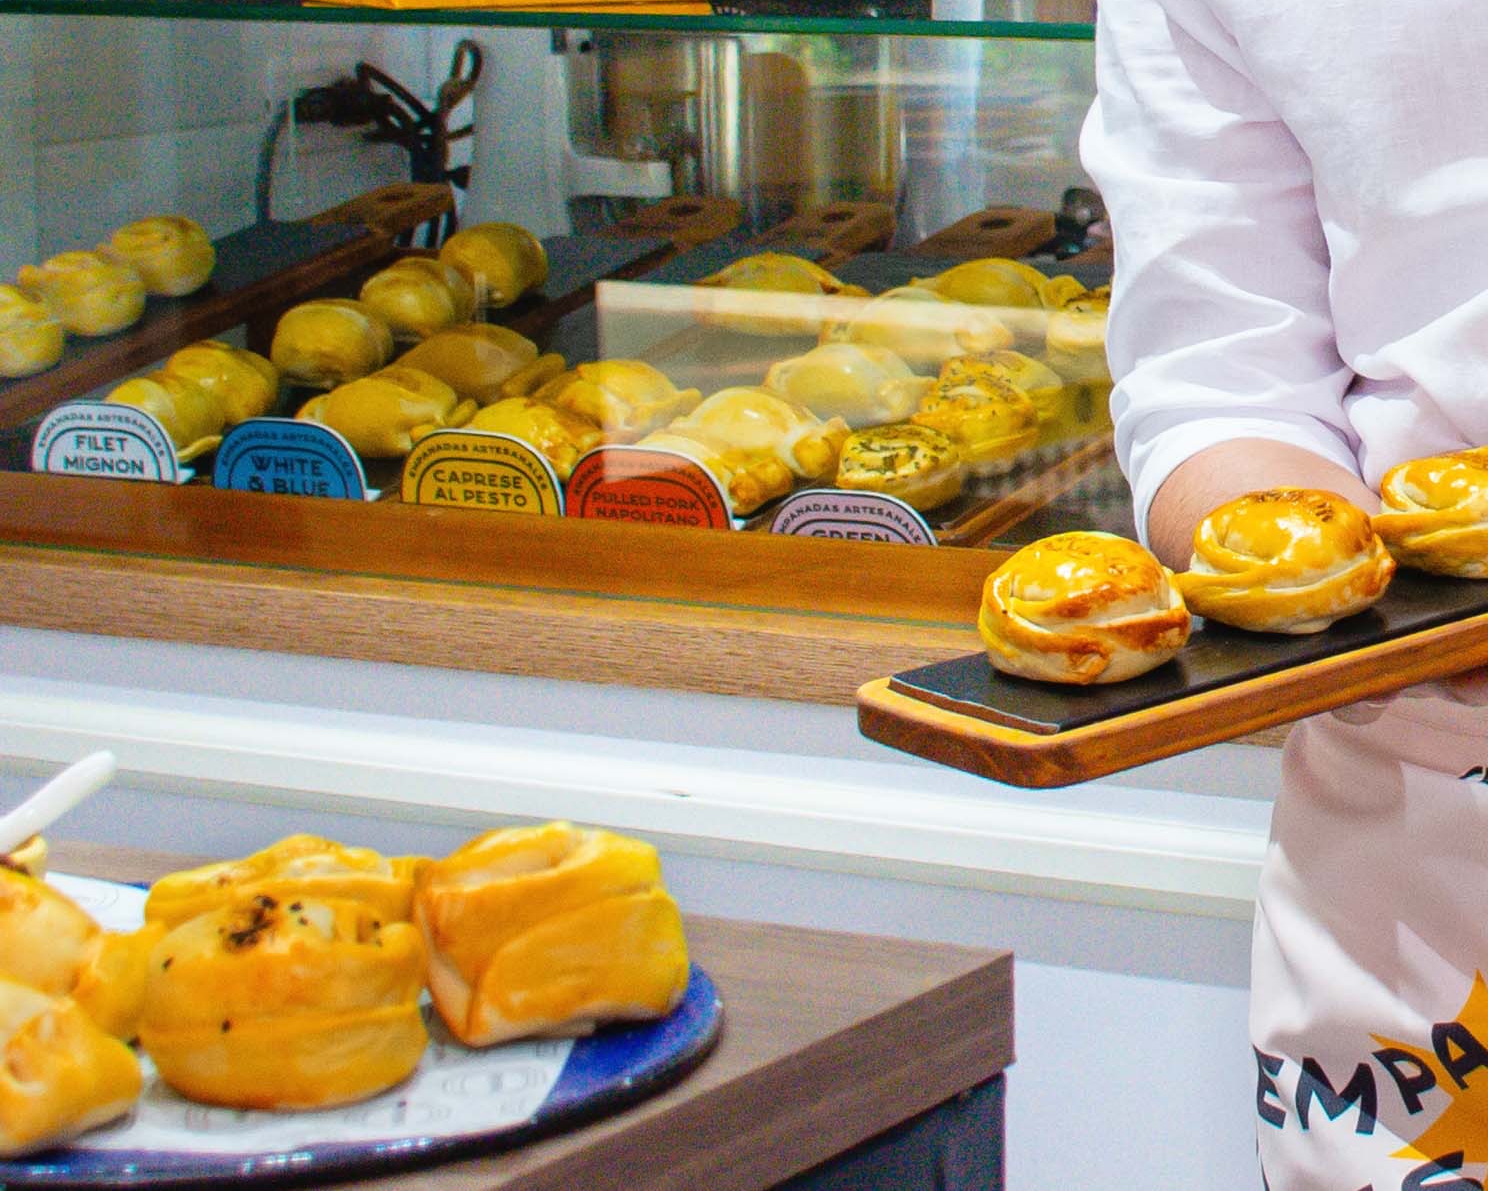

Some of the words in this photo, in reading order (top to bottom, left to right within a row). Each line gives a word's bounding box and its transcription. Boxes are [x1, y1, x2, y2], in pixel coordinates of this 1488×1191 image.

[75, 434, 129, 452] FILET
[63, 455, 145, 475] MIGNON
[251, 455, 323, 476] WHITE
[249, 475, 265, 492] &
[272, 477, 330, 497] BLUE
[433, 469, 523, 490] CAPRESE
[434, 487, 457, 501] AL
[463, 489, 528, 507] PESTO
[592, 491, 651, 507] PULLED
[655, 496, 699, 511] PORK
[594, 506, 700, 526] NAPOLITANO
